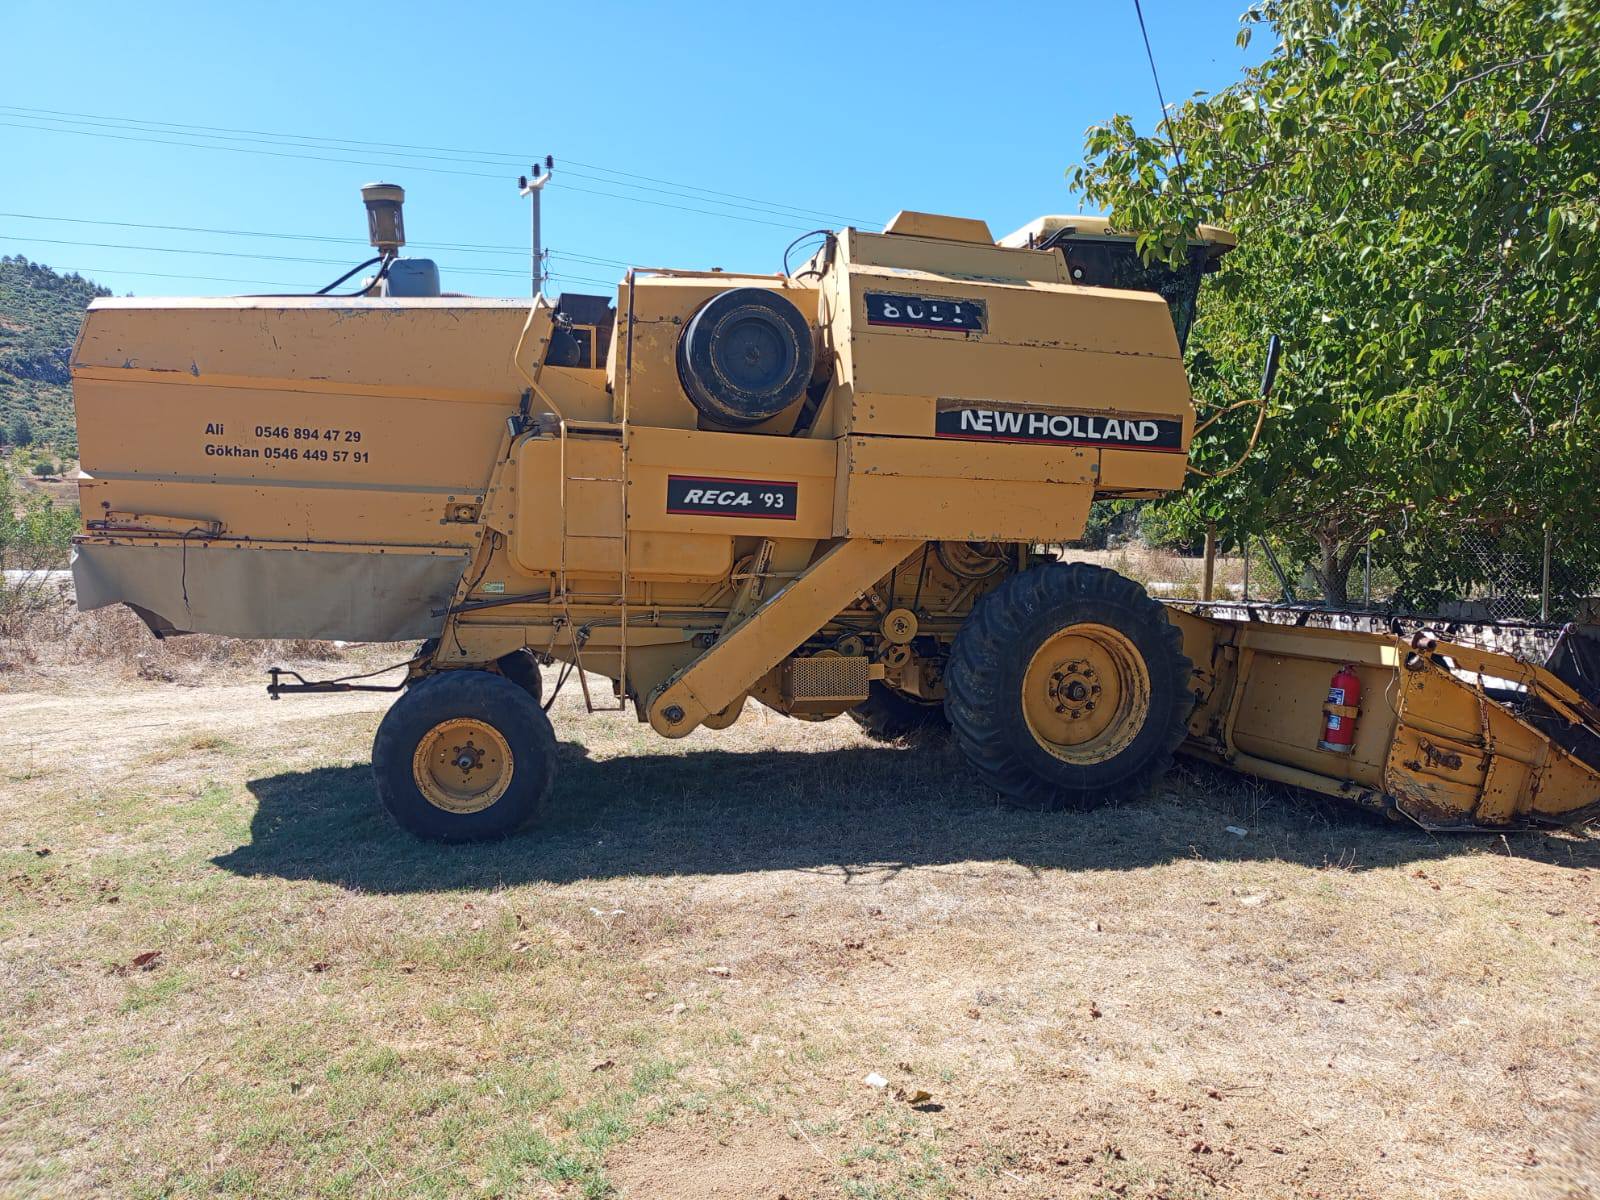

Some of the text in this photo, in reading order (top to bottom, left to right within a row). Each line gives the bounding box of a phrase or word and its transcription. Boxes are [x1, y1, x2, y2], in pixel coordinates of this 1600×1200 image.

[205, 423, 361, 443] Ali 0546 894 47 29
[961, 409, 1159, 442] NEW HOLLAND
[205, 444, 369, 463] Gökhan 0546 449 57 91
[683, 489, 752, 506] RECA
